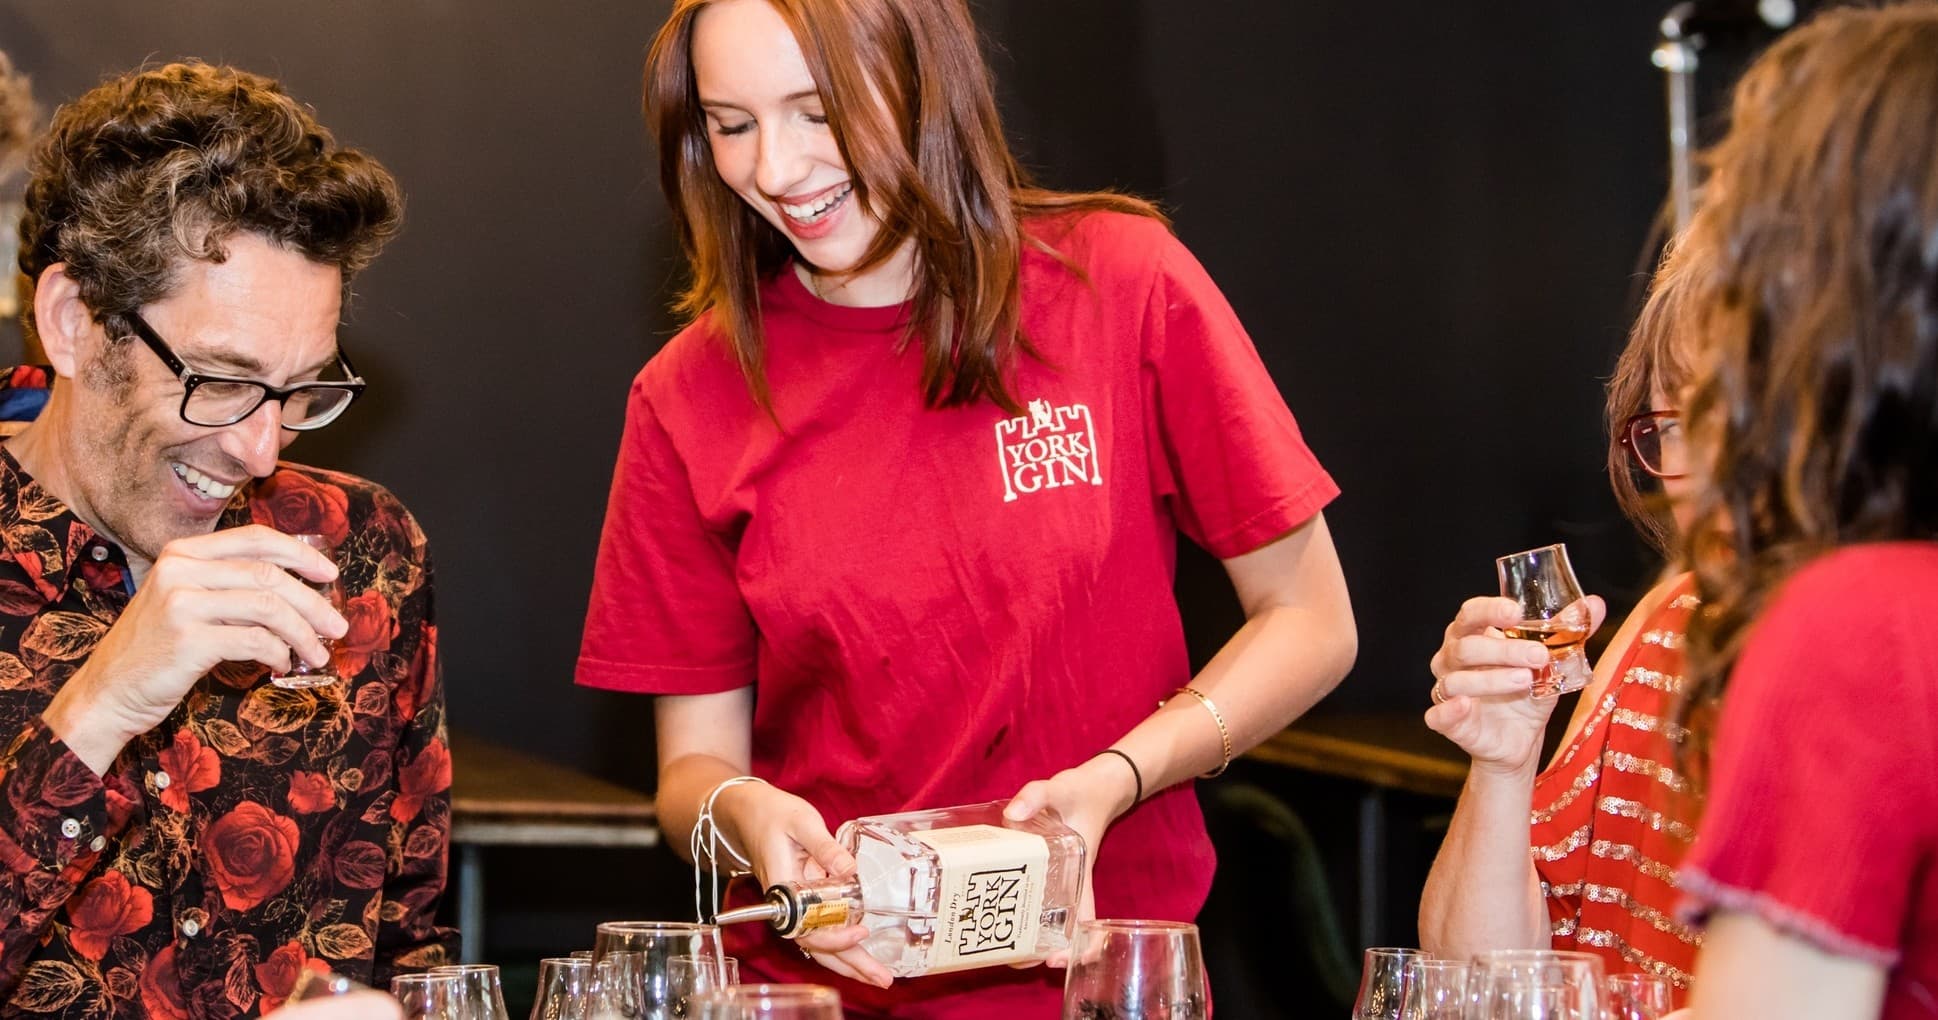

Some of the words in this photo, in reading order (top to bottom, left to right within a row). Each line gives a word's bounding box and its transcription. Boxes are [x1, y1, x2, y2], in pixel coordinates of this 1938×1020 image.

[1006, 432, 1090, 467] YORK
[1014, 455, 1088, 493] GIN
[950, 893, 960, 909] Dry
[977, 876, 1001, 947] YORK
[994, 877, 1020, 942] GIN
[945, 911, 956, 943] London
